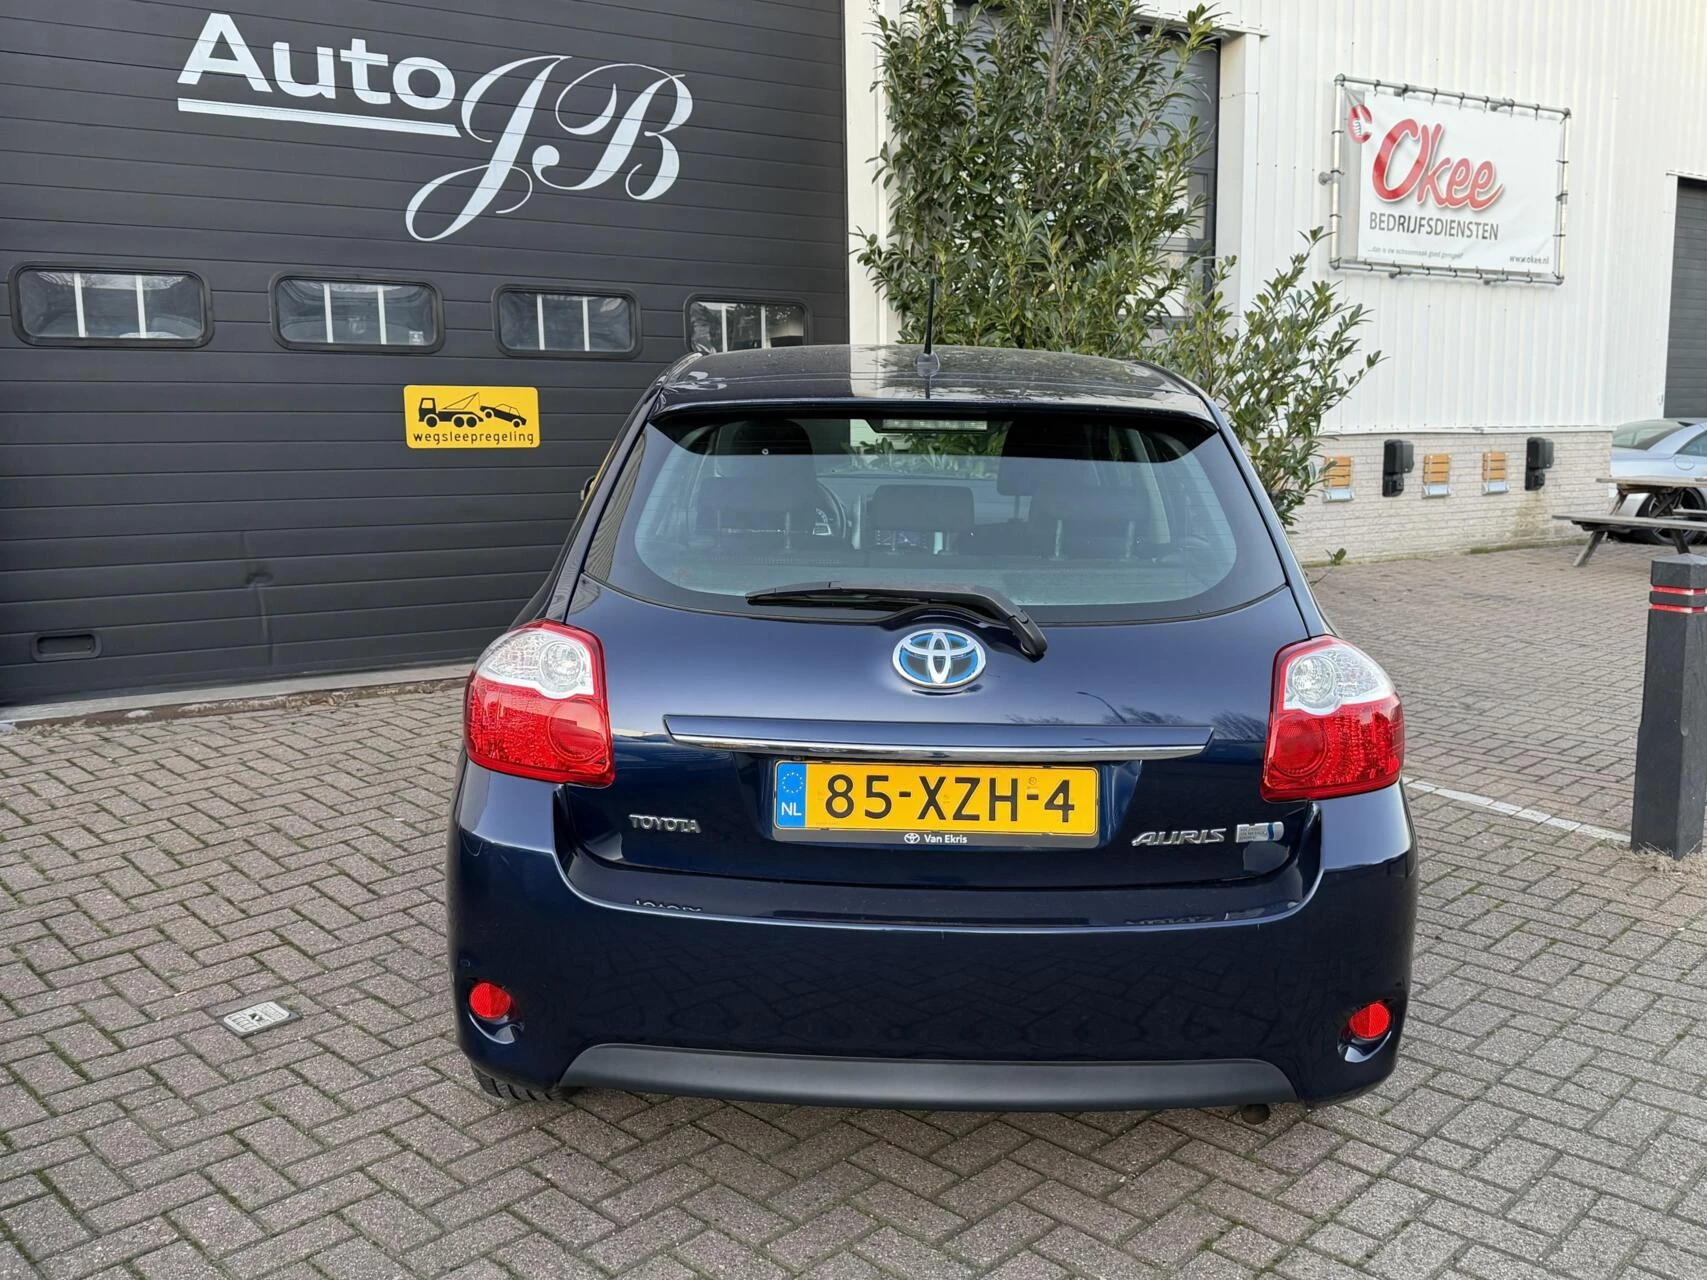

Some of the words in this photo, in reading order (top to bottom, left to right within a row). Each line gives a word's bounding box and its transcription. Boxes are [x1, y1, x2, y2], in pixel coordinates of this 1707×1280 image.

[177, 12, 456, 110] Auto
[405, 55, 693, 241] JB
[1372, 118, 1504, 211] Okee
[1369, 211, 1499, 241] BEDRIJFSDIENSTEN
[413, 431, 534, 445] wegsleepregeling
[781, 803, 802, 816] NL
[825, 774, 1075, 823] 85-XZH-4
[628, 814, 701, 833] TOYOTA
[924, 834, 943, 844] Van
[944, 834, 968, 844] Ekris
[1131, 828, 1227, 847] AURIS
